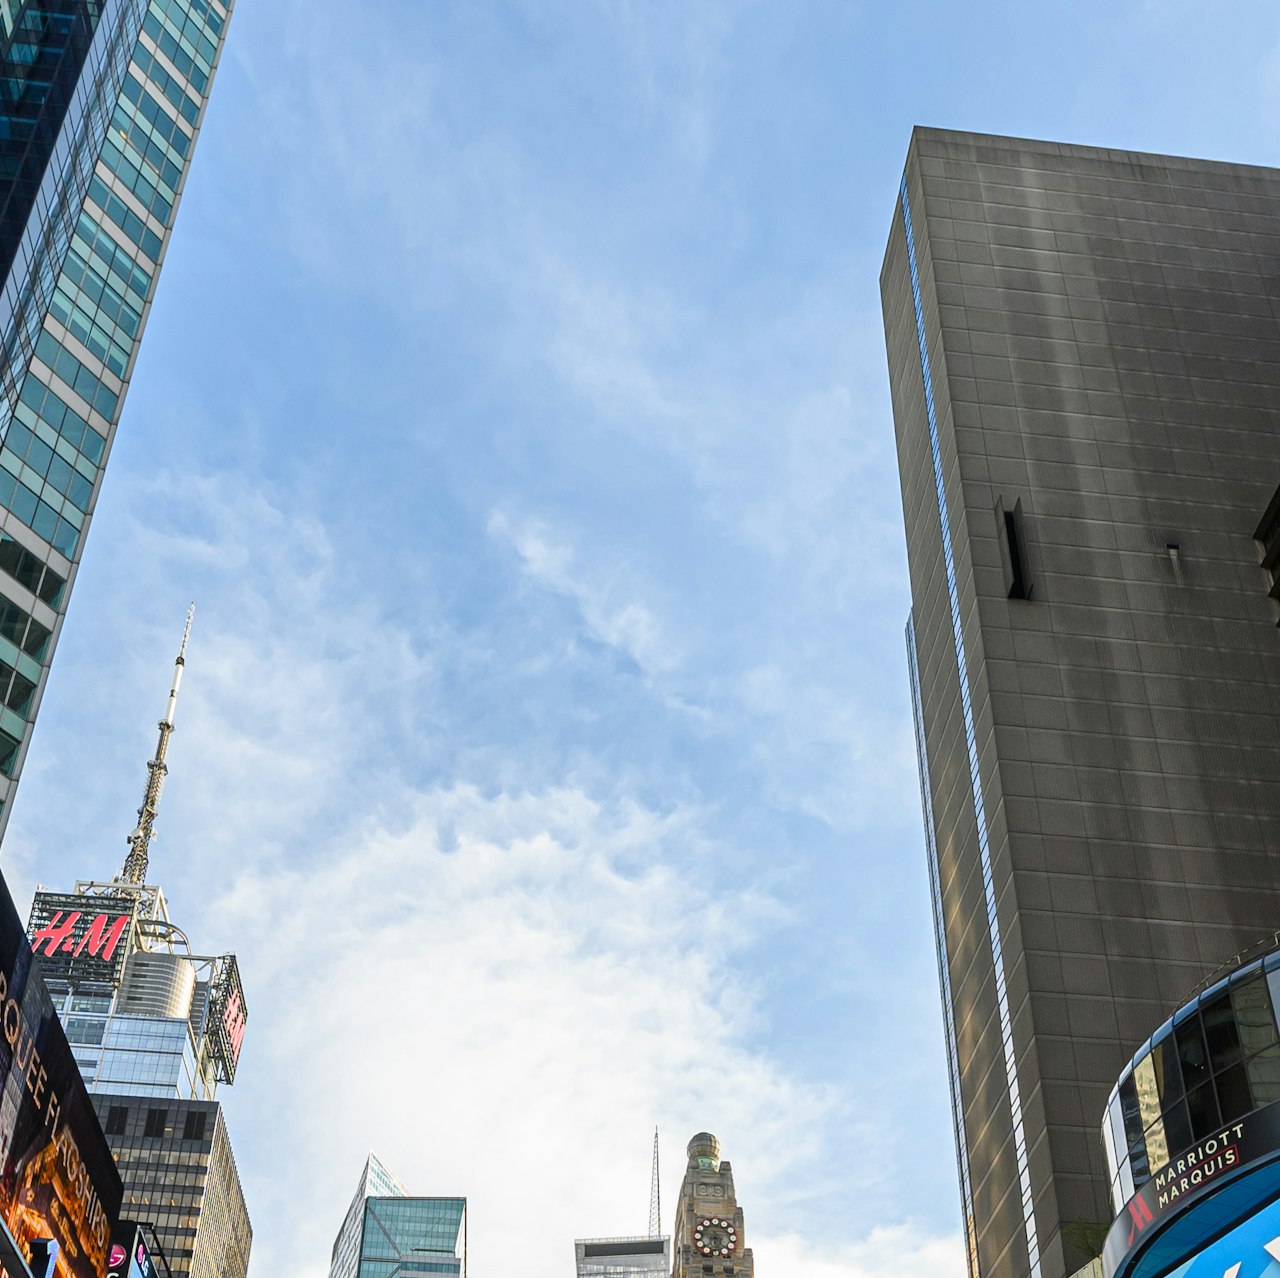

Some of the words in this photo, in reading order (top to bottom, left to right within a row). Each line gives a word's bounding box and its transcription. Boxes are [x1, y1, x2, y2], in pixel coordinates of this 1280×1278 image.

[32, 911, 131, 962] H&M
[1155, 1123, 1245, 1190] MARRIOTT
[1159, 1148, 1237, 1208] MARQUIS
